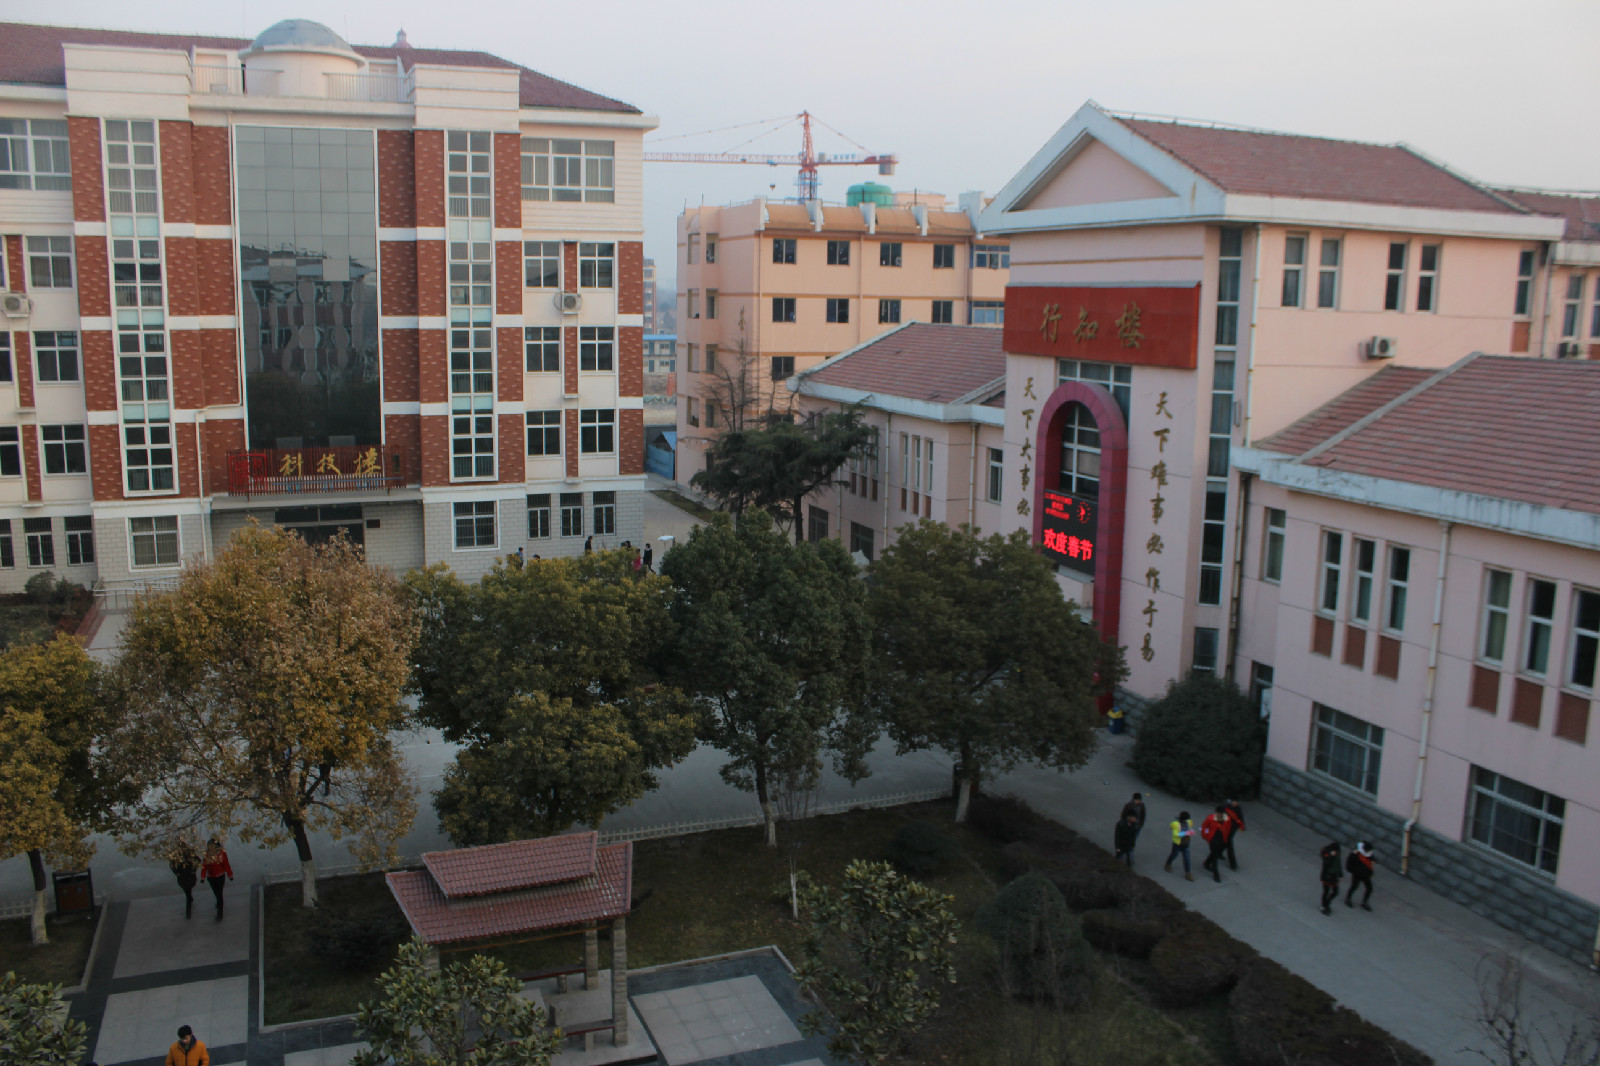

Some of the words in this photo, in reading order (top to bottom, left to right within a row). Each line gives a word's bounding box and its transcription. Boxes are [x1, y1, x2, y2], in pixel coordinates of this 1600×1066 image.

[279, 448, 382, 478] 科技楼
[1044, 528, 1093, 561] 欢度春节
